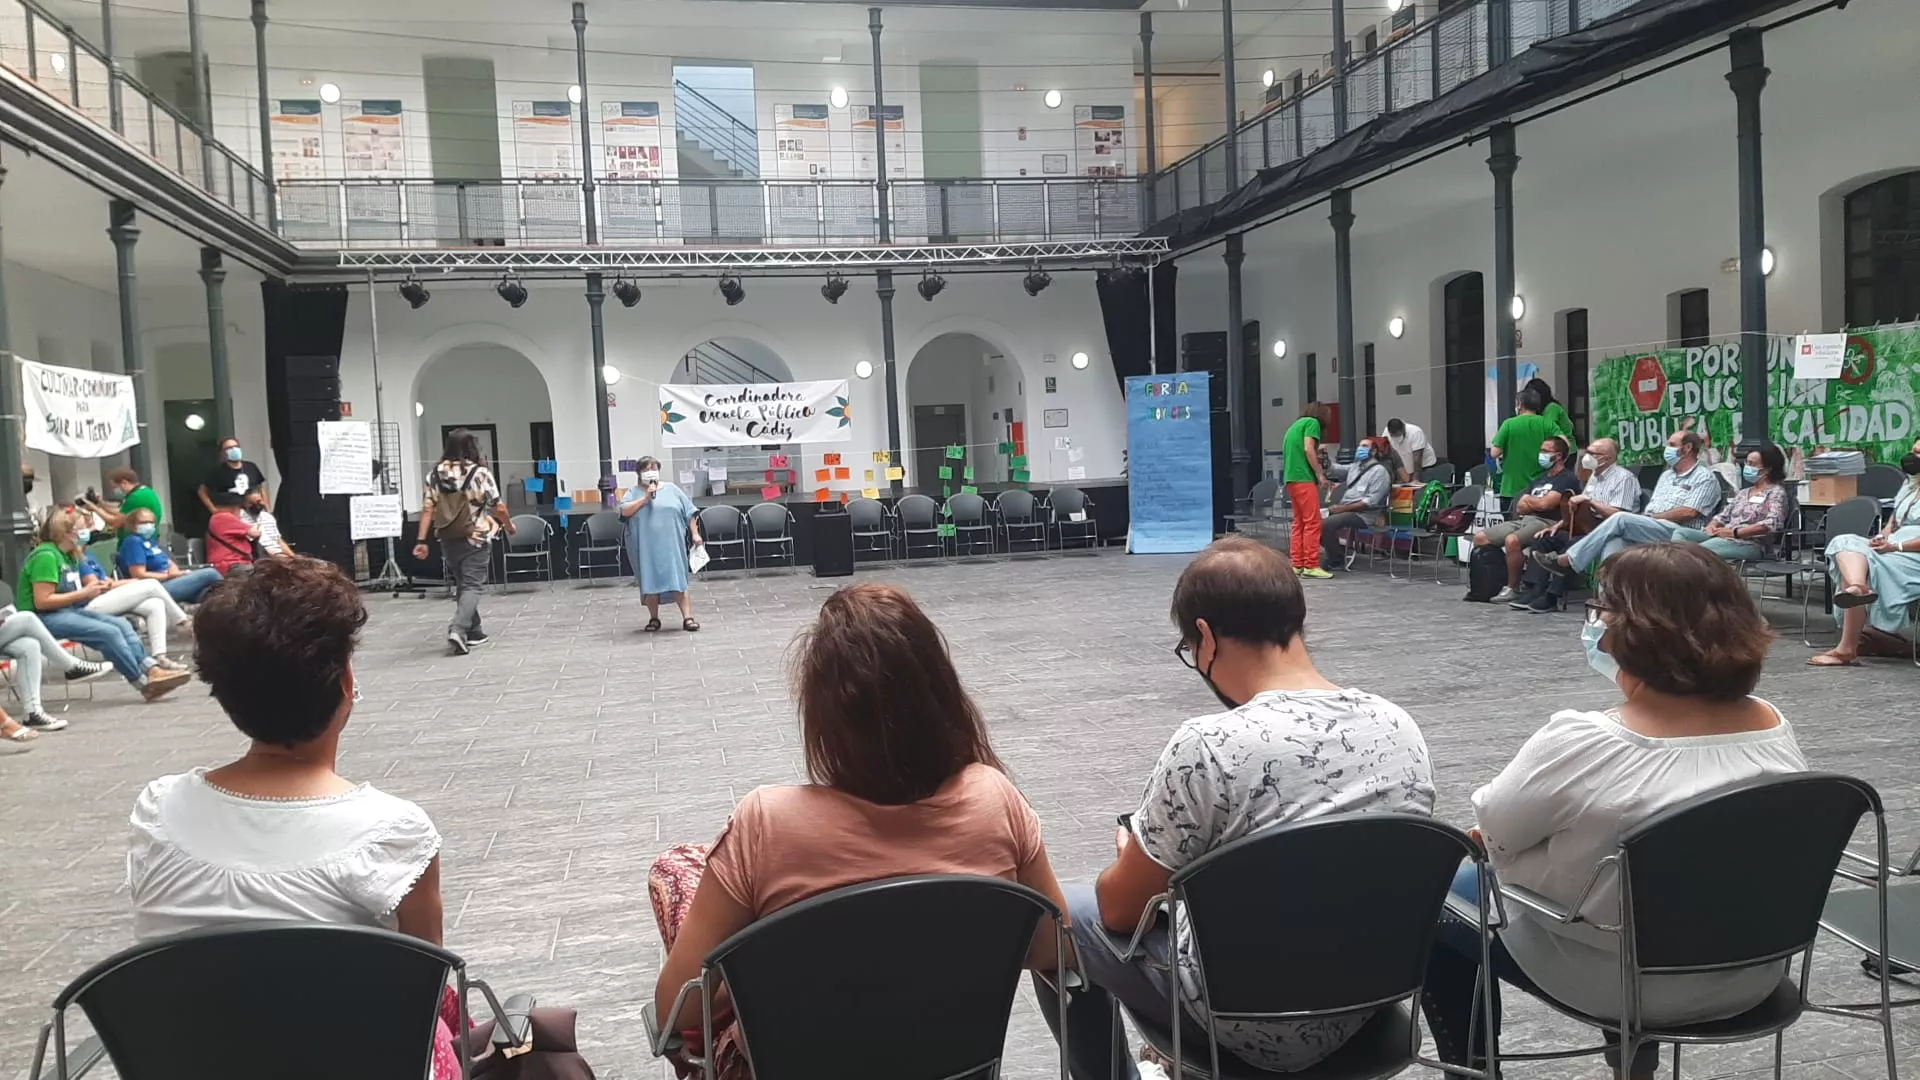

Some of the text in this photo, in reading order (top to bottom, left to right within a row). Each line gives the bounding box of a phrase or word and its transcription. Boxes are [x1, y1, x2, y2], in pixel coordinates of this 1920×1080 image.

[1686, 337, 1796, 378] POR UN
[704, 386, 805, 407] Coordinadora
[730, 420, 793, 441] de Cádiz
[1783, 402, 1911, 445] CALIDAD
